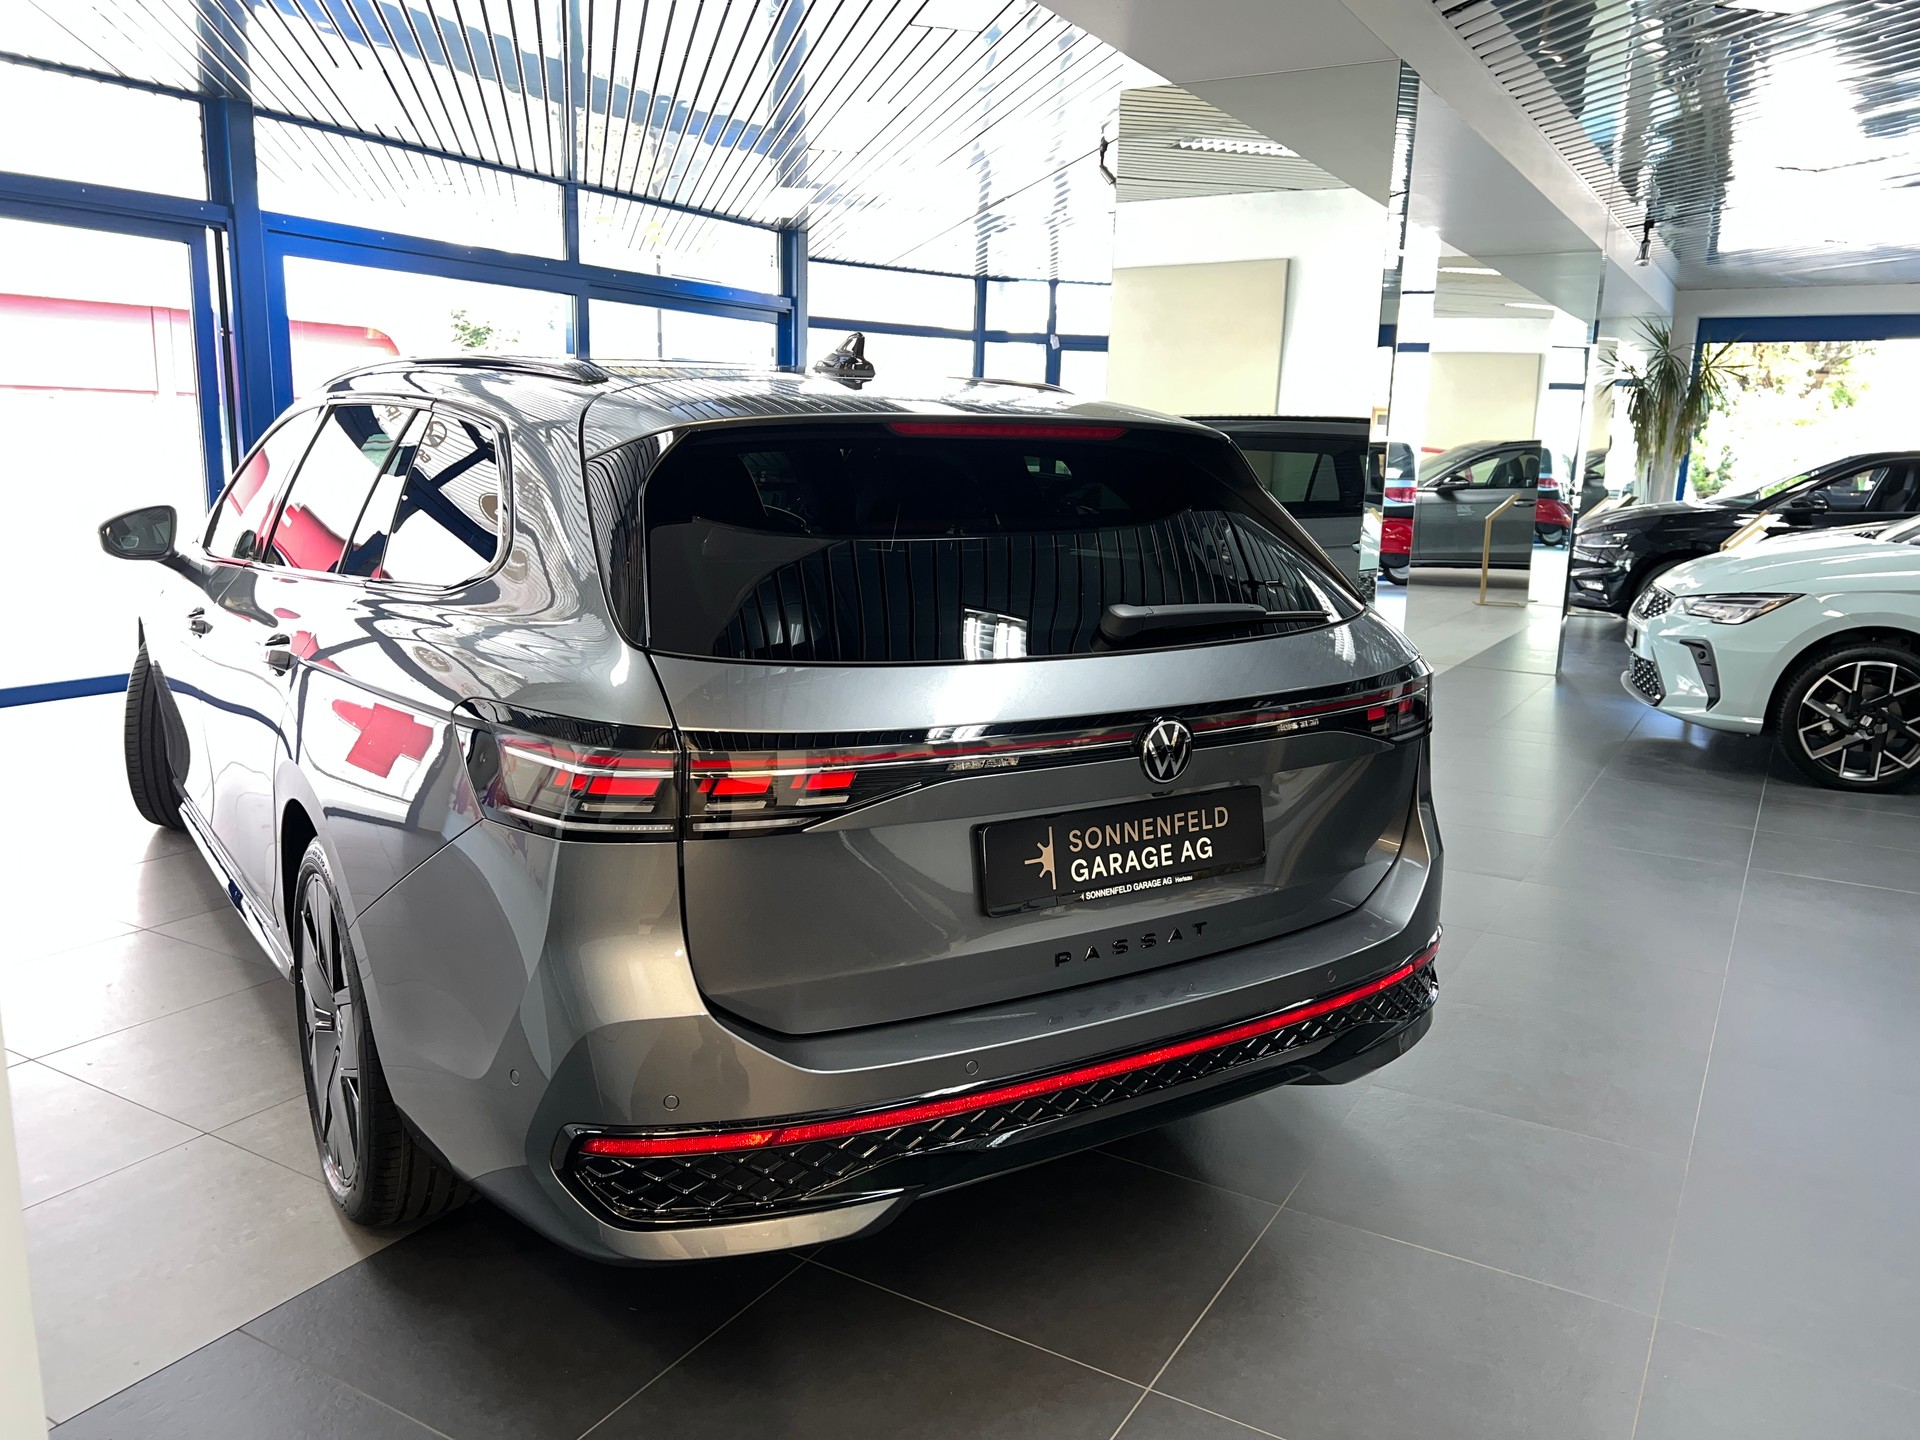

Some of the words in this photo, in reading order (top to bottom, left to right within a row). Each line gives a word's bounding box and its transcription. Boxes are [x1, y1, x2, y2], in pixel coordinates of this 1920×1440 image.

[1068, 806, 1229, 853] SONNENFELD
[1070, 843, 1174, 883] GARAGE
[1180, 836, 1213, 863] AG
[1085, 884, 1133, 900] SONNENFELD
[1133, 878, 1162, 892] GARAGE
[1162, 876, 1173, 887] AG
[1054, 921, 1208, 968] PASSAT
